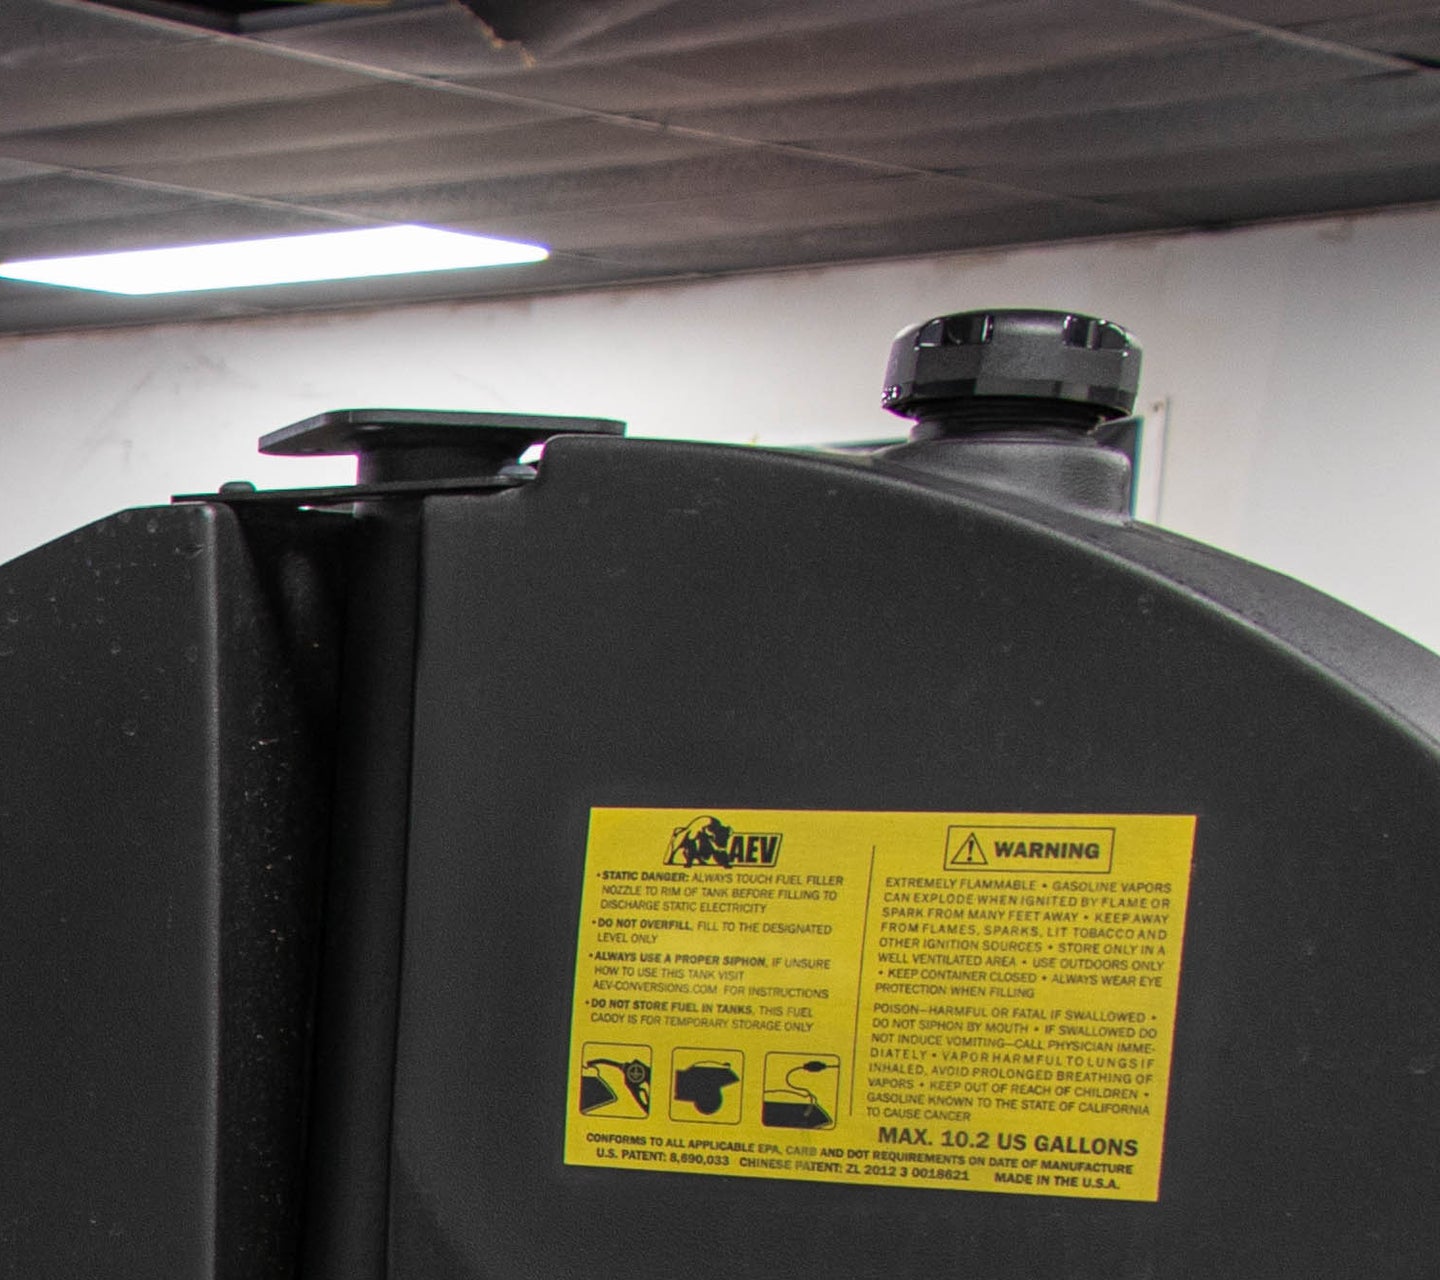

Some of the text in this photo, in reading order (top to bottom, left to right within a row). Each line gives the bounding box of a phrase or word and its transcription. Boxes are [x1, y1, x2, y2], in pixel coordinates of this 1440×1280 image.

[727, 836, 778, 864] AEV
[993, 840, 1100, 862] WARNING
[884, 876, 1172, 893] EXTREMELY FLAMMABLE GASOLINE VAPORS
[881, 907, 1168, 925] SPARK FROM MANY FEET AWAY KEEP AWAY
[878, 937, 1166, 956] OTHER IGNITION SOURCES STORE ONLY IN A
[887, 967, 1162, 987] KEEP CONTAINER CLOSED ALWAYS WEAR EYE
[874, 982, 1035, 998] PROTECTION WHEN FILLING
[877, 1126, 1138, 1158] MAX. 10.2 US GALLONS
[585, 1132, 647, 1146] CONFORMS
[649, 1136, 663, 1147] TO
[665, 1137, 684, 1148] ALL
[687, 1138, 754, 1152] APPLICABLE
[820, 1146, 844, 1158] AND
[846, 1148, 869, 1159] DOT
[872, 1149, 965, 1165] REQUIREMENTS
[968, 1155, 985, 1166] ON
[988, 1156, 1018, 1168] DATE
[1020, 1158, 1037, 1169] OF
[1040, 1159, 1133, 1175] MANUFACTURE
[993, 1171, 1118, 1190] MADE IN THE U.S.A.
